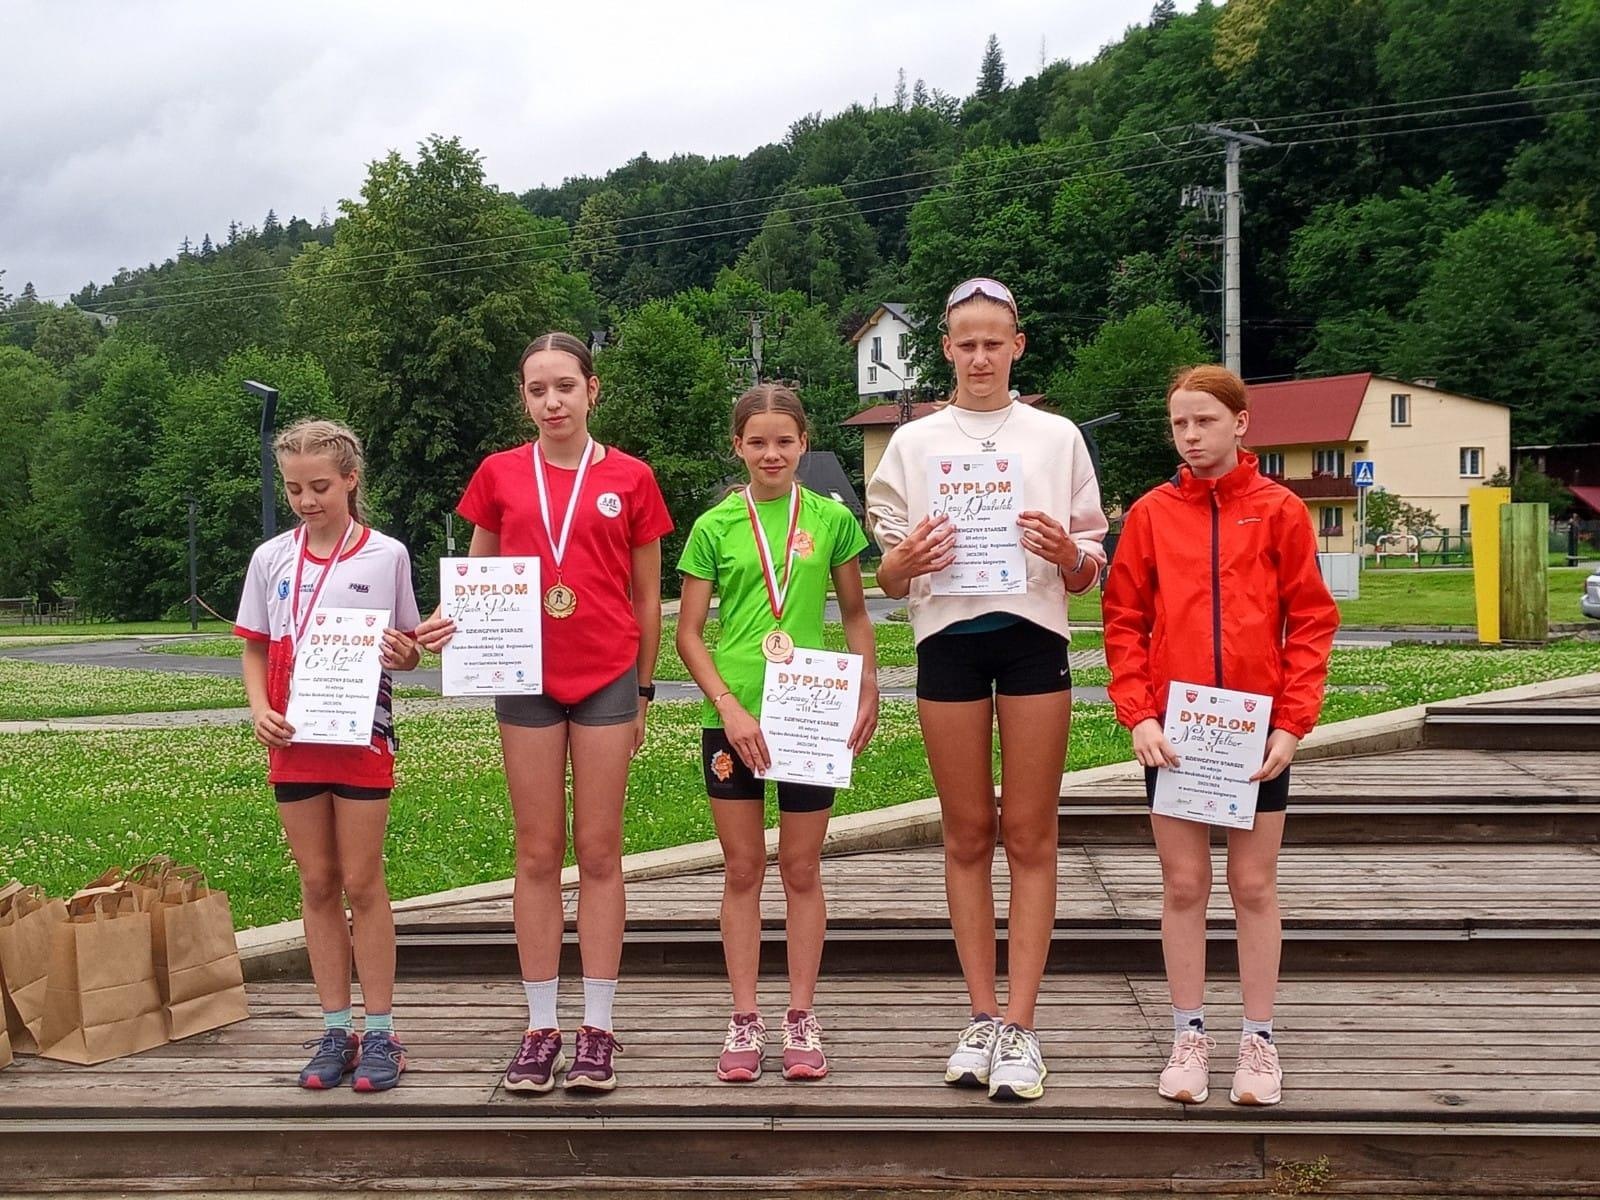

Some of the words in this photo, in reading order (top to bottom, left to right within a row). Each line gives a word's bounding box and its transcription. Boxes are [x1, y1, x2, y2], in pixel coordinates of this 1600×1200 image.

[940, 481, 1011, 495] DYPLOM
[454, 583, 528, 596] DYPLOM
[311, 634, 375, 646] DYPLOM
[778, 672, 849, 691] DYPLOM
[1180, 710, 1256, 733] DYPLOM
